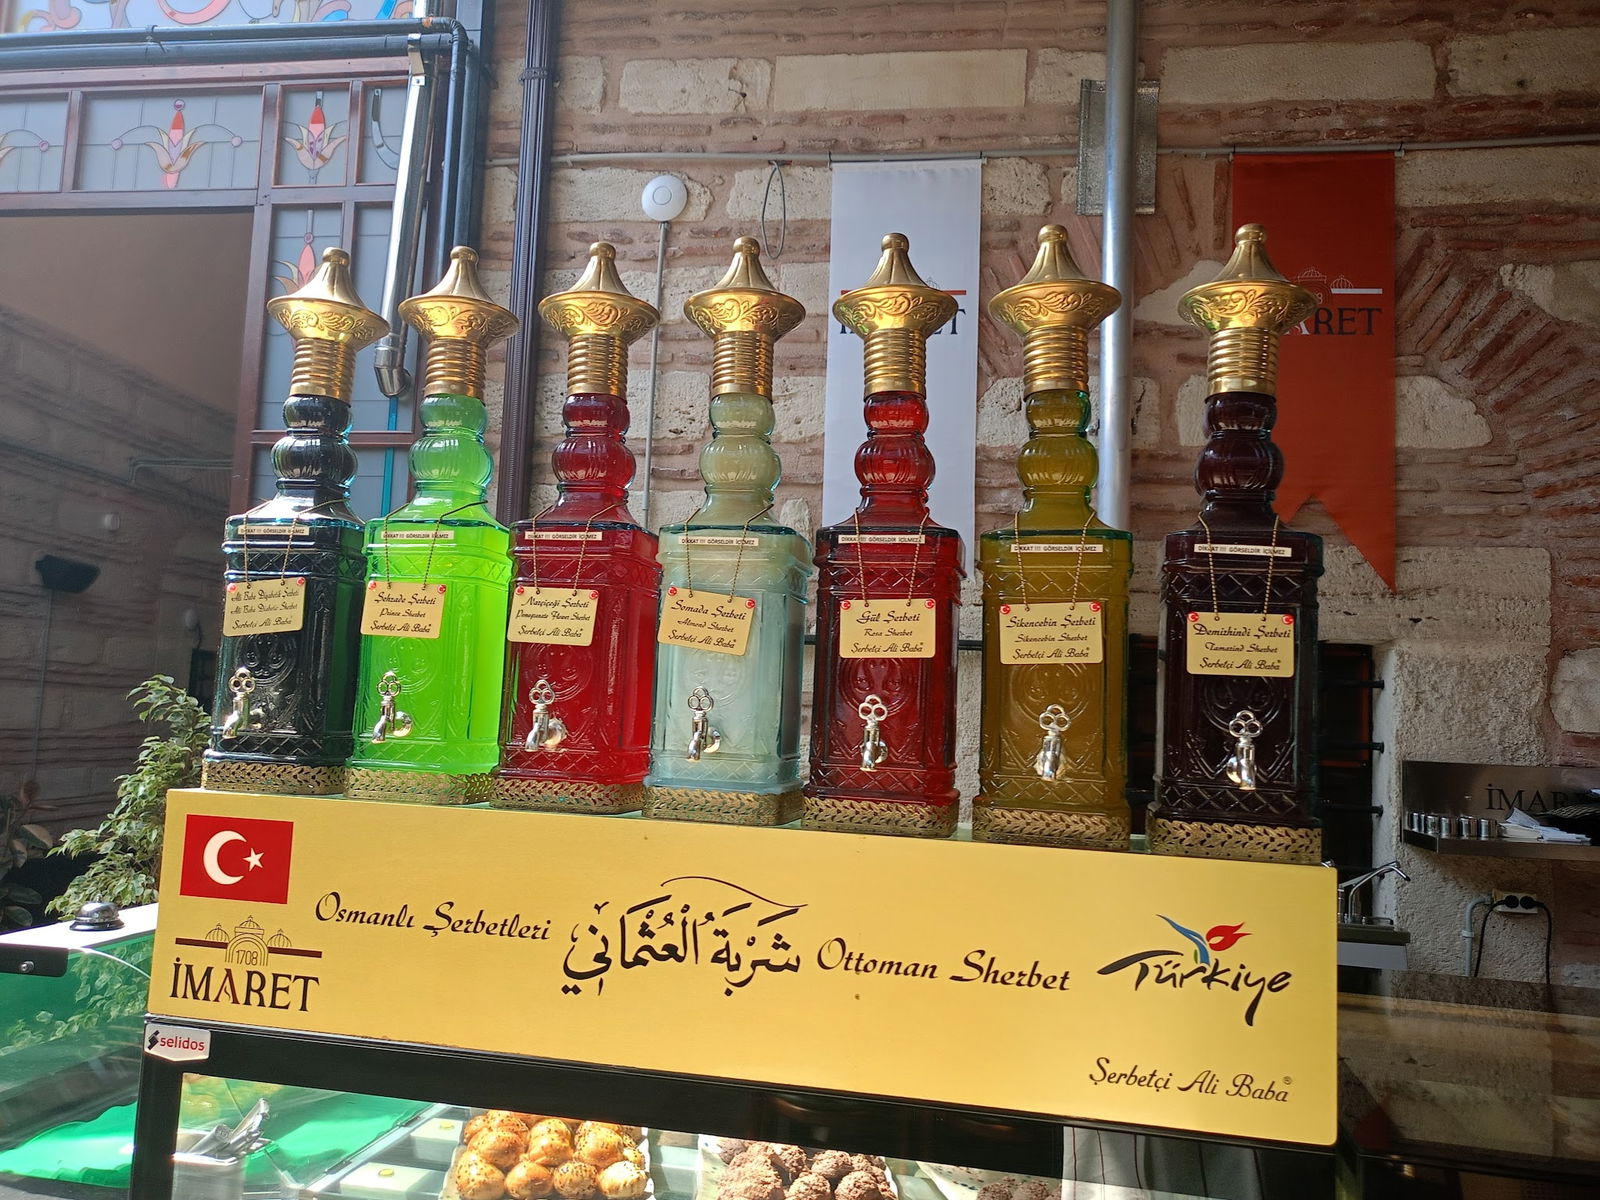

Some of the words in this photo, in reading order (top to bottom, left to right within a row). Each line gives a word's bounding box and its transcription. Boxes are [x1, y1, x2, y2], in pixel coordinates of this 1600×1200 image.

[1284, 306, 1383, 335] RET
[374, 591, 406, 603] Şehzade
[407, 593, 437, 605] Şerbeti
[561, 598, 590, 608] Şerbeti
[379, 607, 401, 617] Prince
[402, 609, 426, 618] Sherbet
[570, 612, 591, 621] Sherbet
[670, 599, 709, 614] Somada
[711, 605, 747, 620] Şerbeti
[258, 618, 271, 627] Ali
[677, 617, 707, 628] Almond
[707, 621, 734, 633] Sherbet
[856, 610, 881, 625] Gül
[883, 610, 921, 624] Şerbeti
[1005, 615, 1058, 628] Sikencebin
[1060, 614, 1096, 629] Şerbeti
[370, 620, 396, 632] Şerbetçi
[397, 623, 410, 632] Ali
[518, 625, 545, 636] Şerbetçi
[546, 627, 560, 637] Ali
[884, 627, 913, 637] Sherbet
[1193, 623, 1251, 637] Demirhindi
[1253, 625, 1292, 639] Şerbeti
[668, 629, 698, 643] Şerbetçi
[697, 635, 712, 645] Ali
[1014, 633, 1056, 643] Sikencebin
[1057, 632, 1088, 642] Sherbet
[850, 642, 882, 654] Şerbetçi
[883, 642, 898, 653] Ali
[1012, 648, 1045, 660] Şerbetçi
[1046, 648, 1062, 658] Ali
[1204, 642, 1245, 652] Tamarind
[1246, 643, 1278, 653] Sherbet
[1199, 657, 1234, 670] Şerbetçi
[1235, 659, 1254, 670] Ali
[314, 891, 414, 928] Osmanlı
[422, 900, 552, 940] Şerbetleri
[236, 949, 258, 966] 1708
[816, 936, 938, 979] Ottoman
[949, 949, 1071, 991] Sherbet
[169, 957, 320, 1012] İMARET
[1096, 949, 1293, 1027] Türkiye
[160, 1036, 205, 1051] selidos
[1088, 1057, 1173, 1092] Şerbetçi
[1177, 1070, 1220, 1095] Ali
